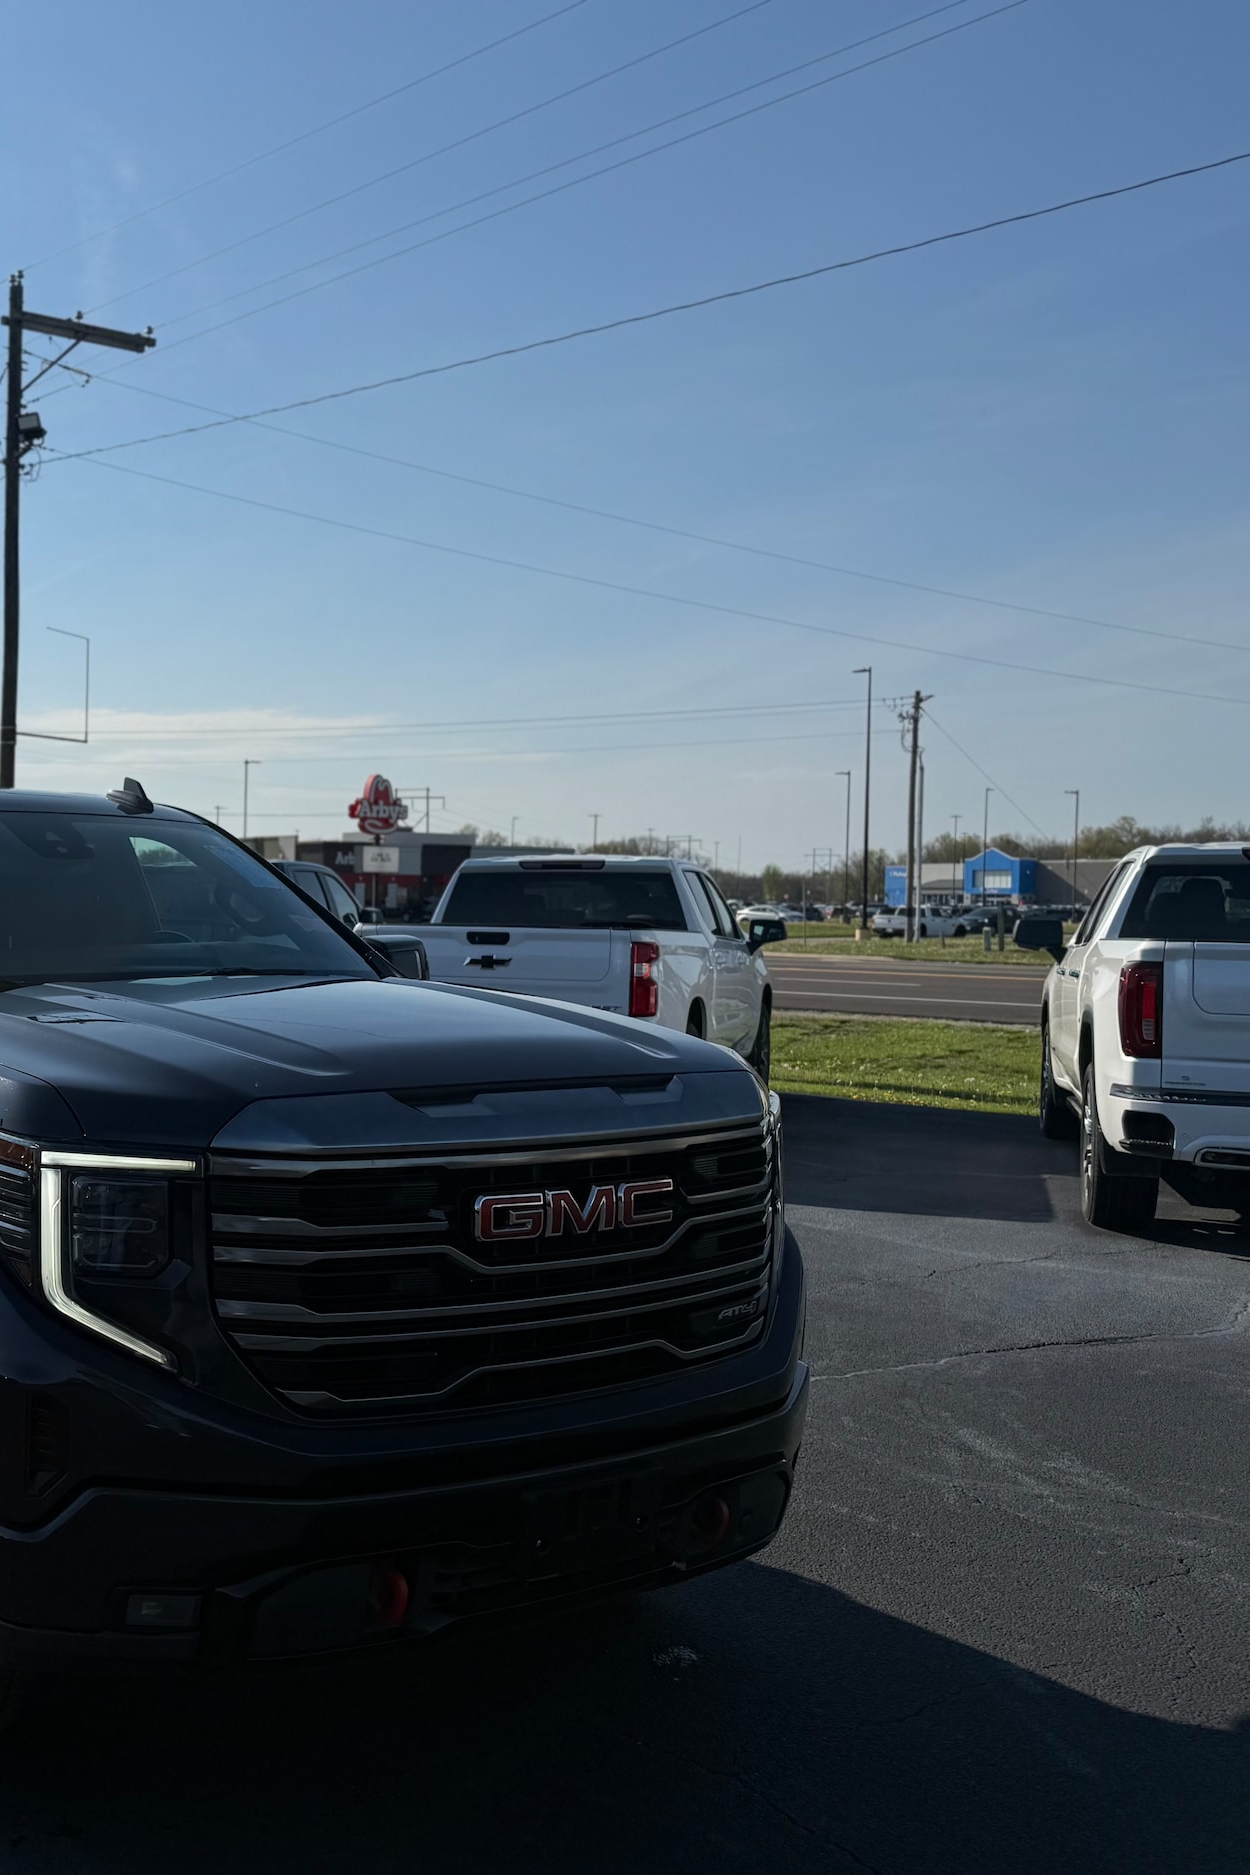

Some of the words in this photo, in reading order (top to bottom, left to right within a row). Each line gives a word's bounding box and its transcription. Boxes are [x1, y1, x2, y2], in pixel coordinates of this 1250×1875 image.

[359, 799, 408, 823] Arby's
[474, 1178, 674, 1242] GMC
[718, 1300, 757, 1320] AT4
